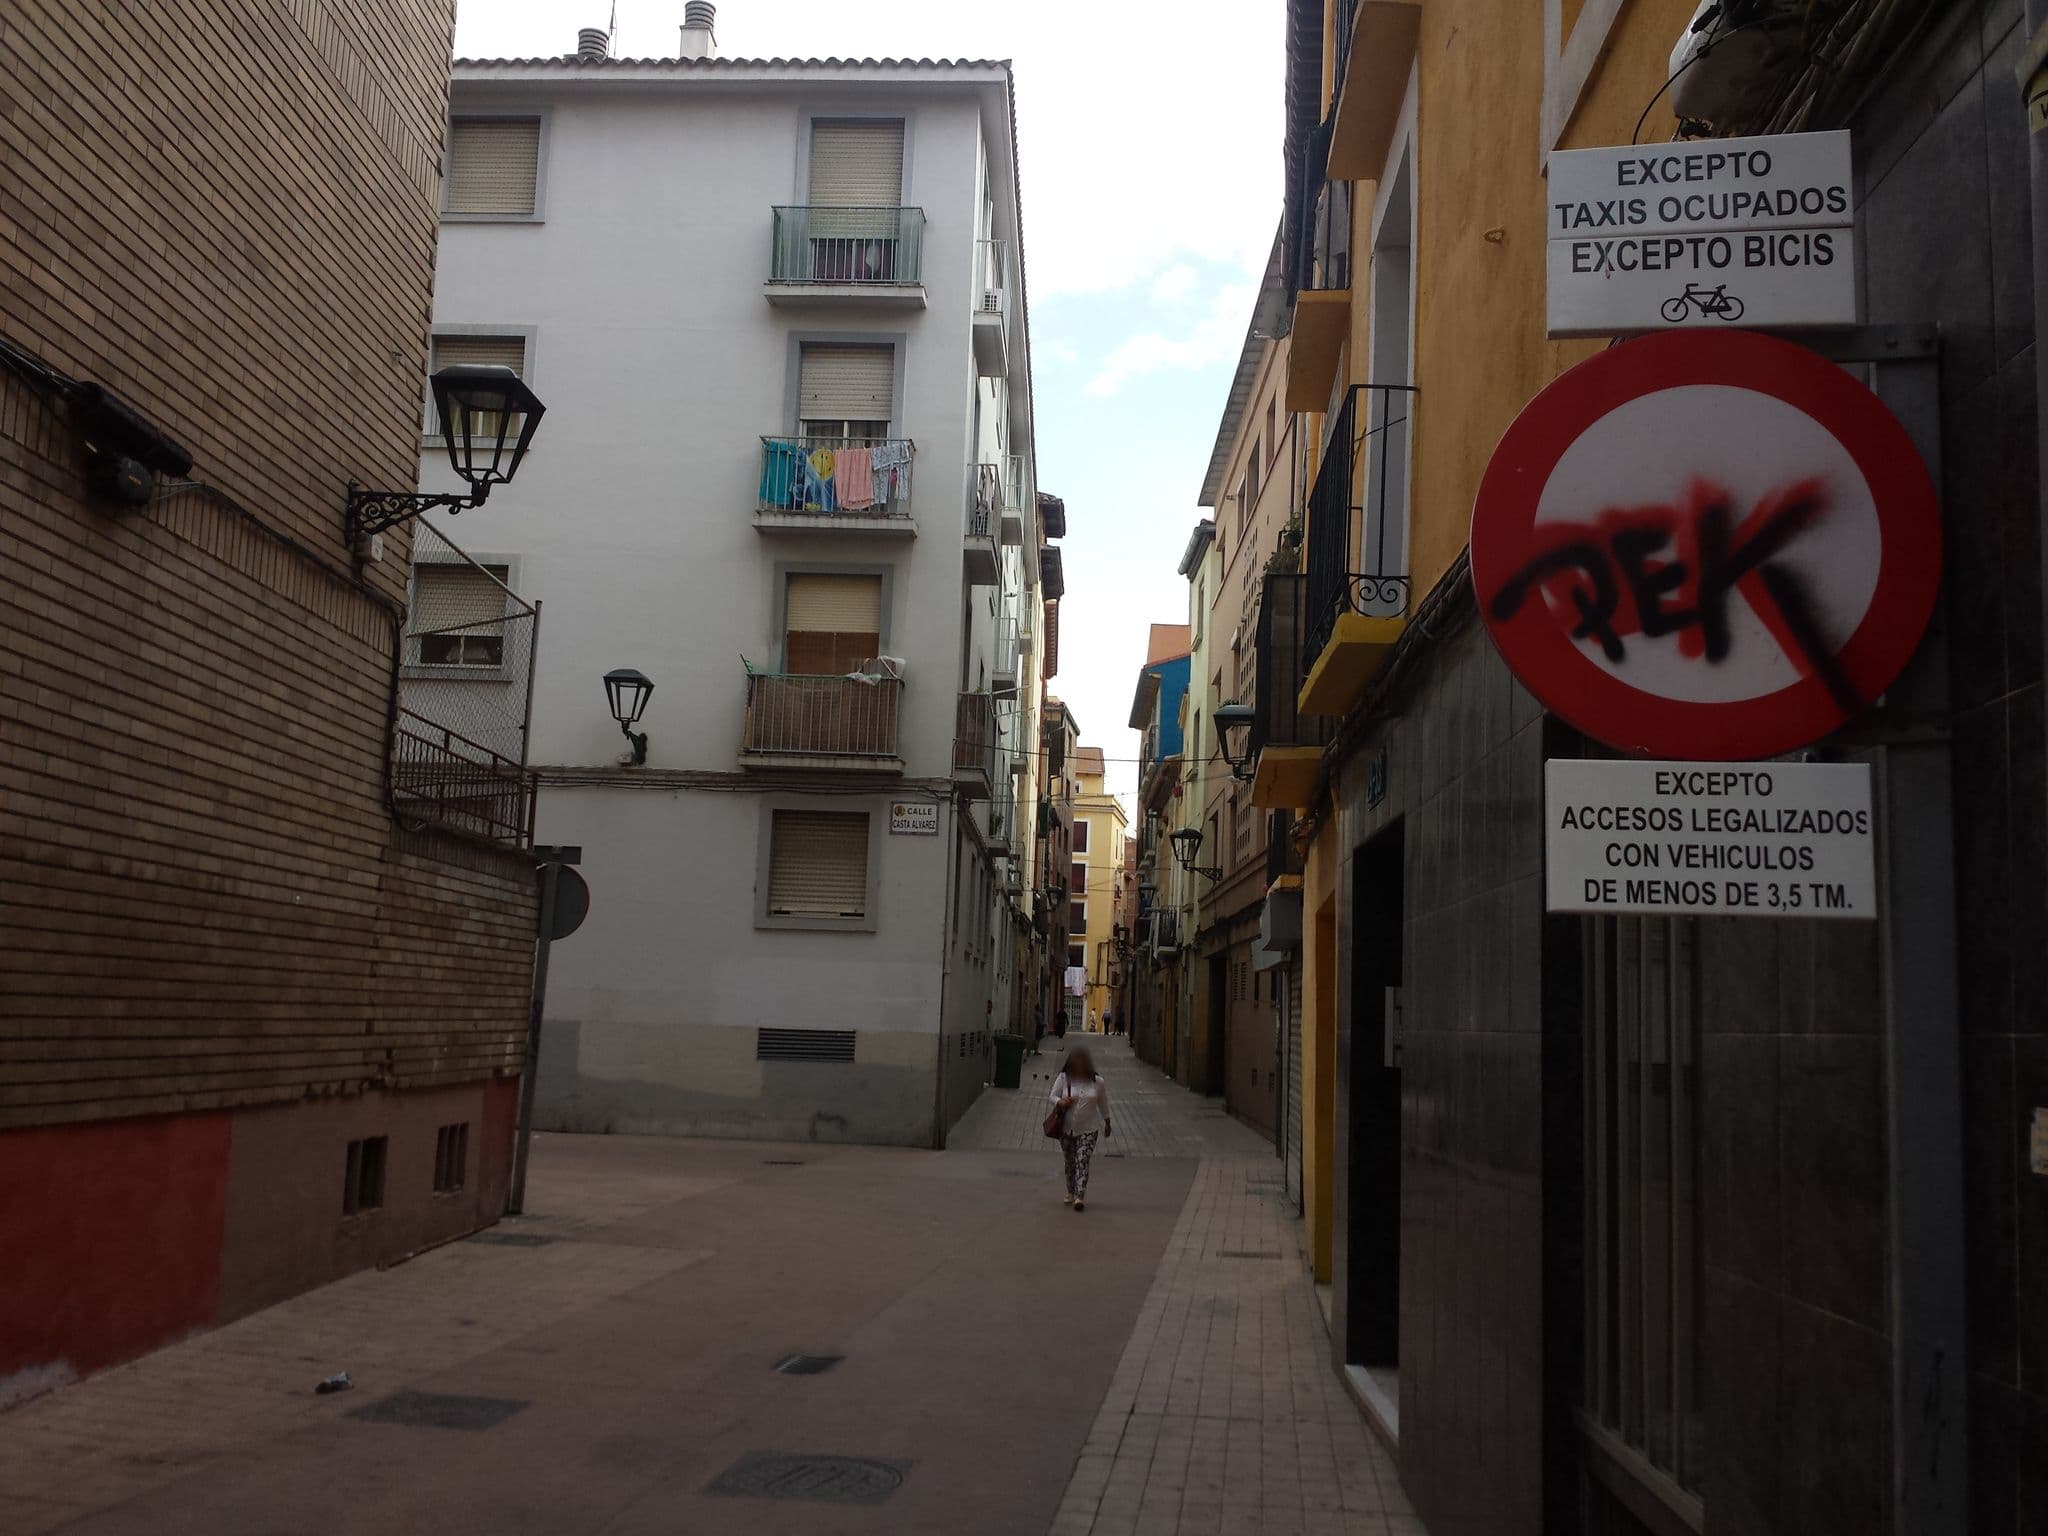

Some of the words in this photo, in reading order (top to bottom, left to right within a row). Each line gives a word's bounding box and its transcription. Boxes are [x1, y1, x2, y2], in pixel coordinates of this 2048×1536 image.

[1617, 150, 1771, 186] EXCEPTO
[1555, 199, 1648, 229] TAXIS
[1658, 186, 1847, 222] OCUPADOS
[1572, 236, 1731, 273] EXCEPTO
[1744, 233, 1834, 267] BICIS
[1655, 771, 1773, 796] EXCEPTO
[907, 807, 933, 816] CALLE
[1561, 806, 1683, 832] ACCESOS
[1692, 808, 1868, 835] LEGALIZADOS
[1605, 843, 1660, 868] CON
[1667, 844, 1815, 871] VEHICULOS
[1584, 878, 1618, 904] DE
[1625, 879, 1717, 906] MENOS
[1725, 882, 1759, 907] DE
[1767, 883, 1802, 911] 3,5
[1809, 883, 1853, 909] TM.
